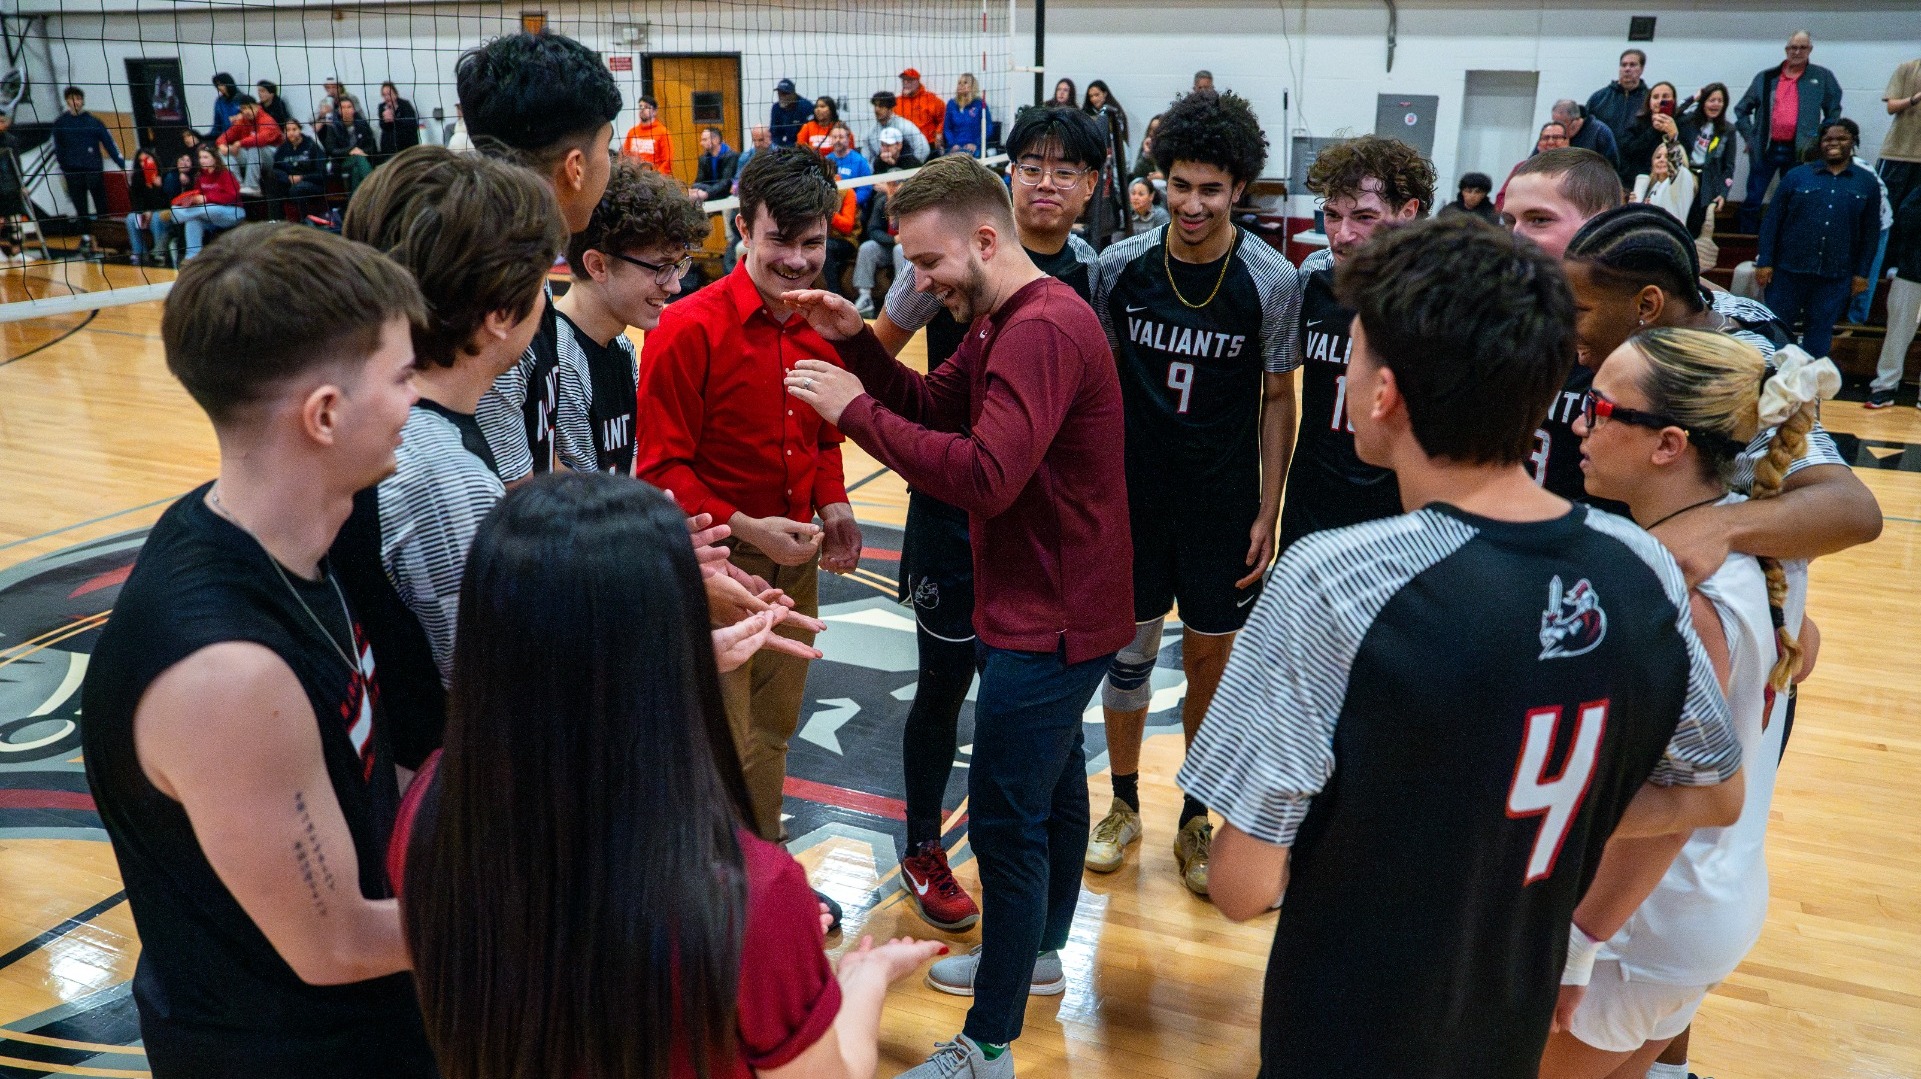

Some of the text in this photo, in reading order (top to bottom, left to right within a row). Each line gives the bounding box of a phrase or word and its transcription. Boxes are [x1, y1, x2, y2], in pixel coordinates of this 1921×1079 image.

[1128, 316, 1246, 358] VALIANTS
[1306, 330, 1353, 365] VALI
[1167, 361, 1195, 414] 9
[1505, 698, 1611, 887] 4
